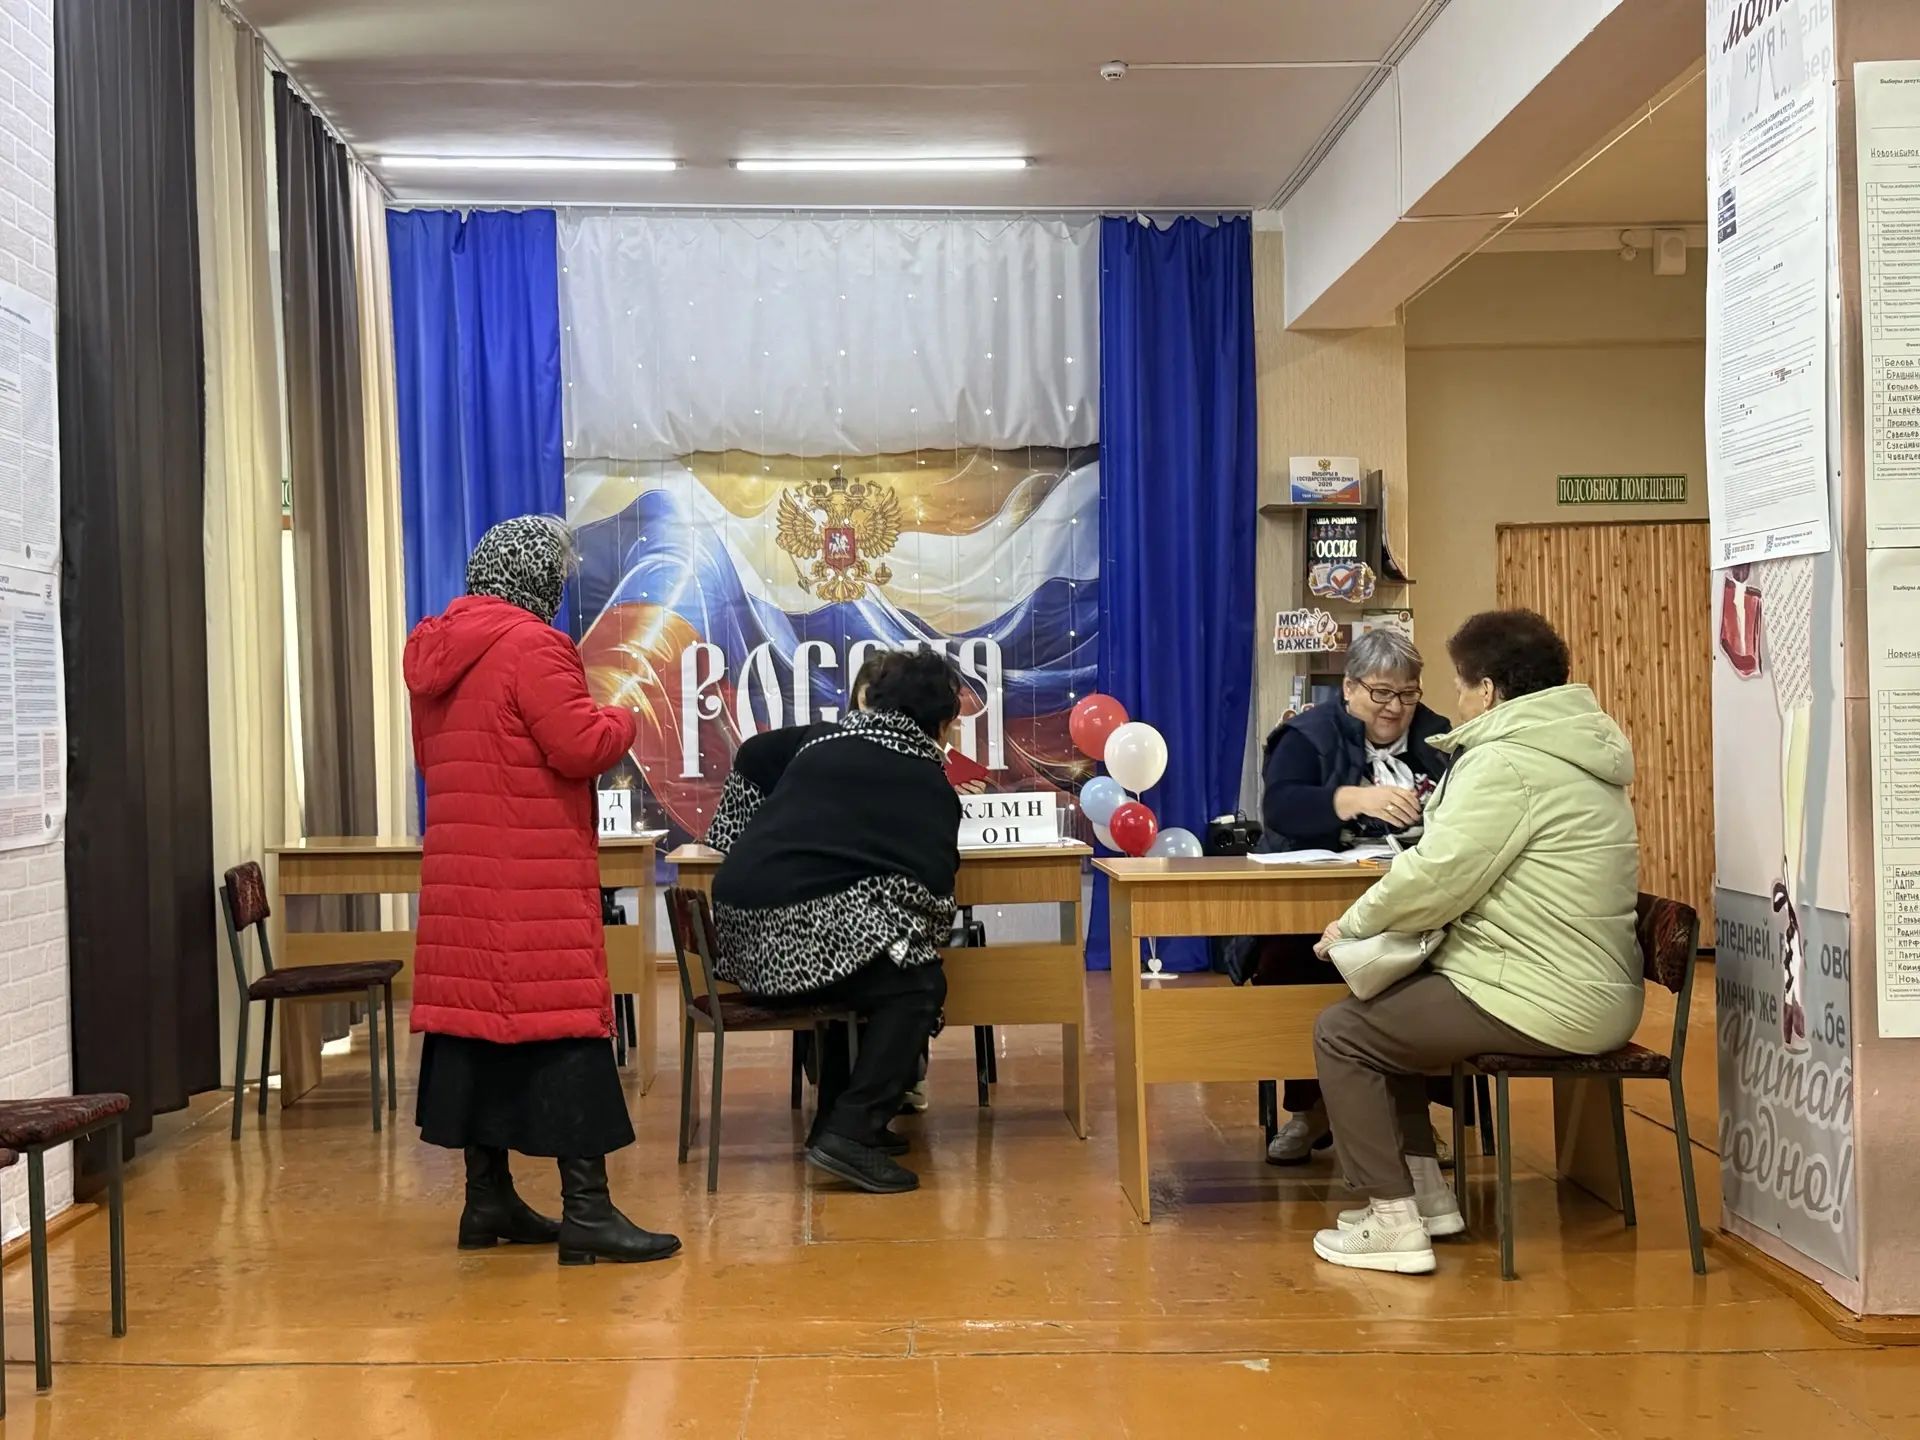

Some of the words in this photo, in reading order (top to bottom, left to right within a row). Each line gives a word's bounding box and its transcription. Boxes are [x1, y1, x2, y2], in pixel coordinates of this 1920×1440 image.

[1560, 479, 1619, 503] ПОДСОБНОЕ
[1621, 477, 1685, 501] ПОМЕЩЕНИЕ
[1331, 516, 1358, 525] РОДИНА
[1279, 611, 1308, 626] МОЙ
[1278, 627, 1313, 638] ГОЛОС
[1895, 879, 1914, 889] ЛДПР
[1898, 939, 1920, 948] КПРФ
